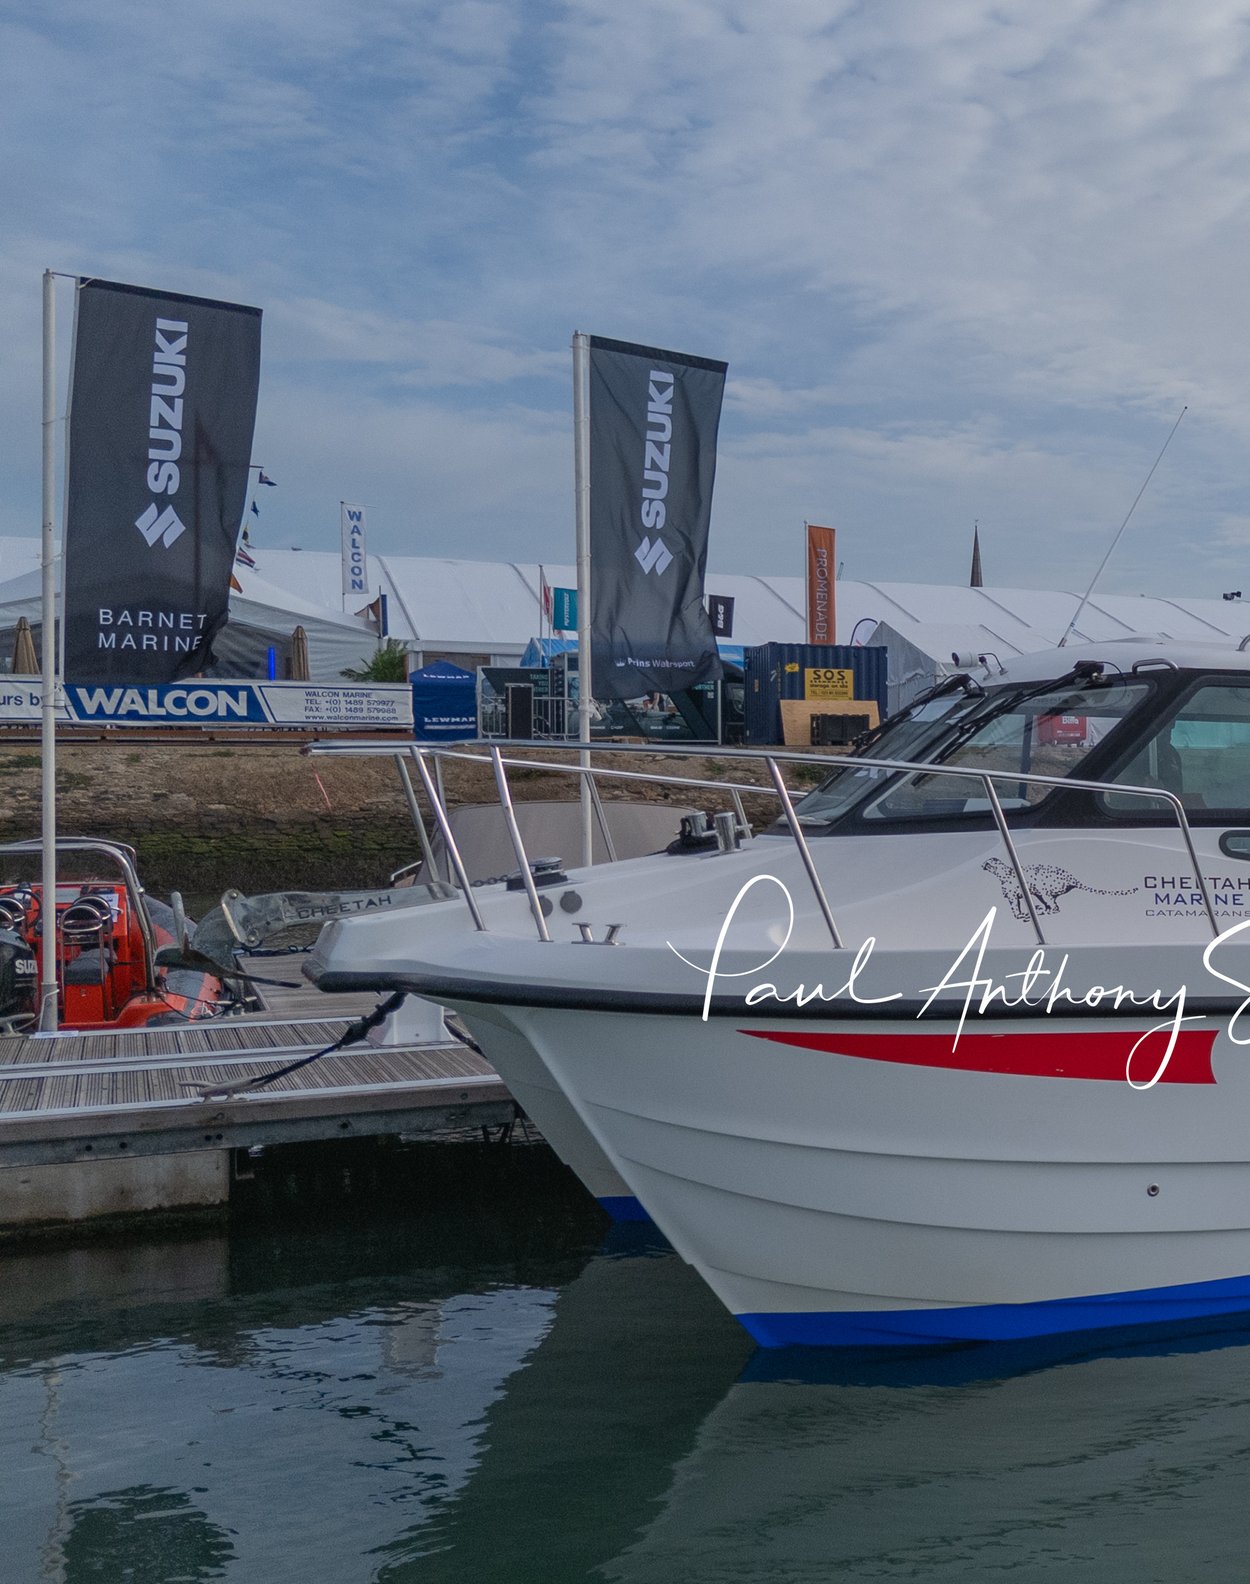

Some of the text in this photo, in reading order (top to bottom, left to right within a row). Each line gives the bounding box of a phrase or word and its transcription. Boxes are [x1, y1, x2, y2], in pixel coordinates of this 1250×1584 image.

[148, 317, 188, 495] SUZUKI
[641, 370, 674, 529] SUZUKI
[347, 510, 364, 590] WALCON
[815, 547, 828, 641] PROMENADE
[99, 608, 207, 630] BARNET
[98, 632, 203, 652] MARINE
[627, 657, 651, 668] Prins
[813, 670, 846, 681] SOS
[30, 692, 43, 706] b
[76, 688, 248, 716] WALCON
[304, 714, 399, 722] www.walconmarine.com
[296, 895, 392, 919] CHEETAH
[1154, 892, 1245, 906] MARNE
